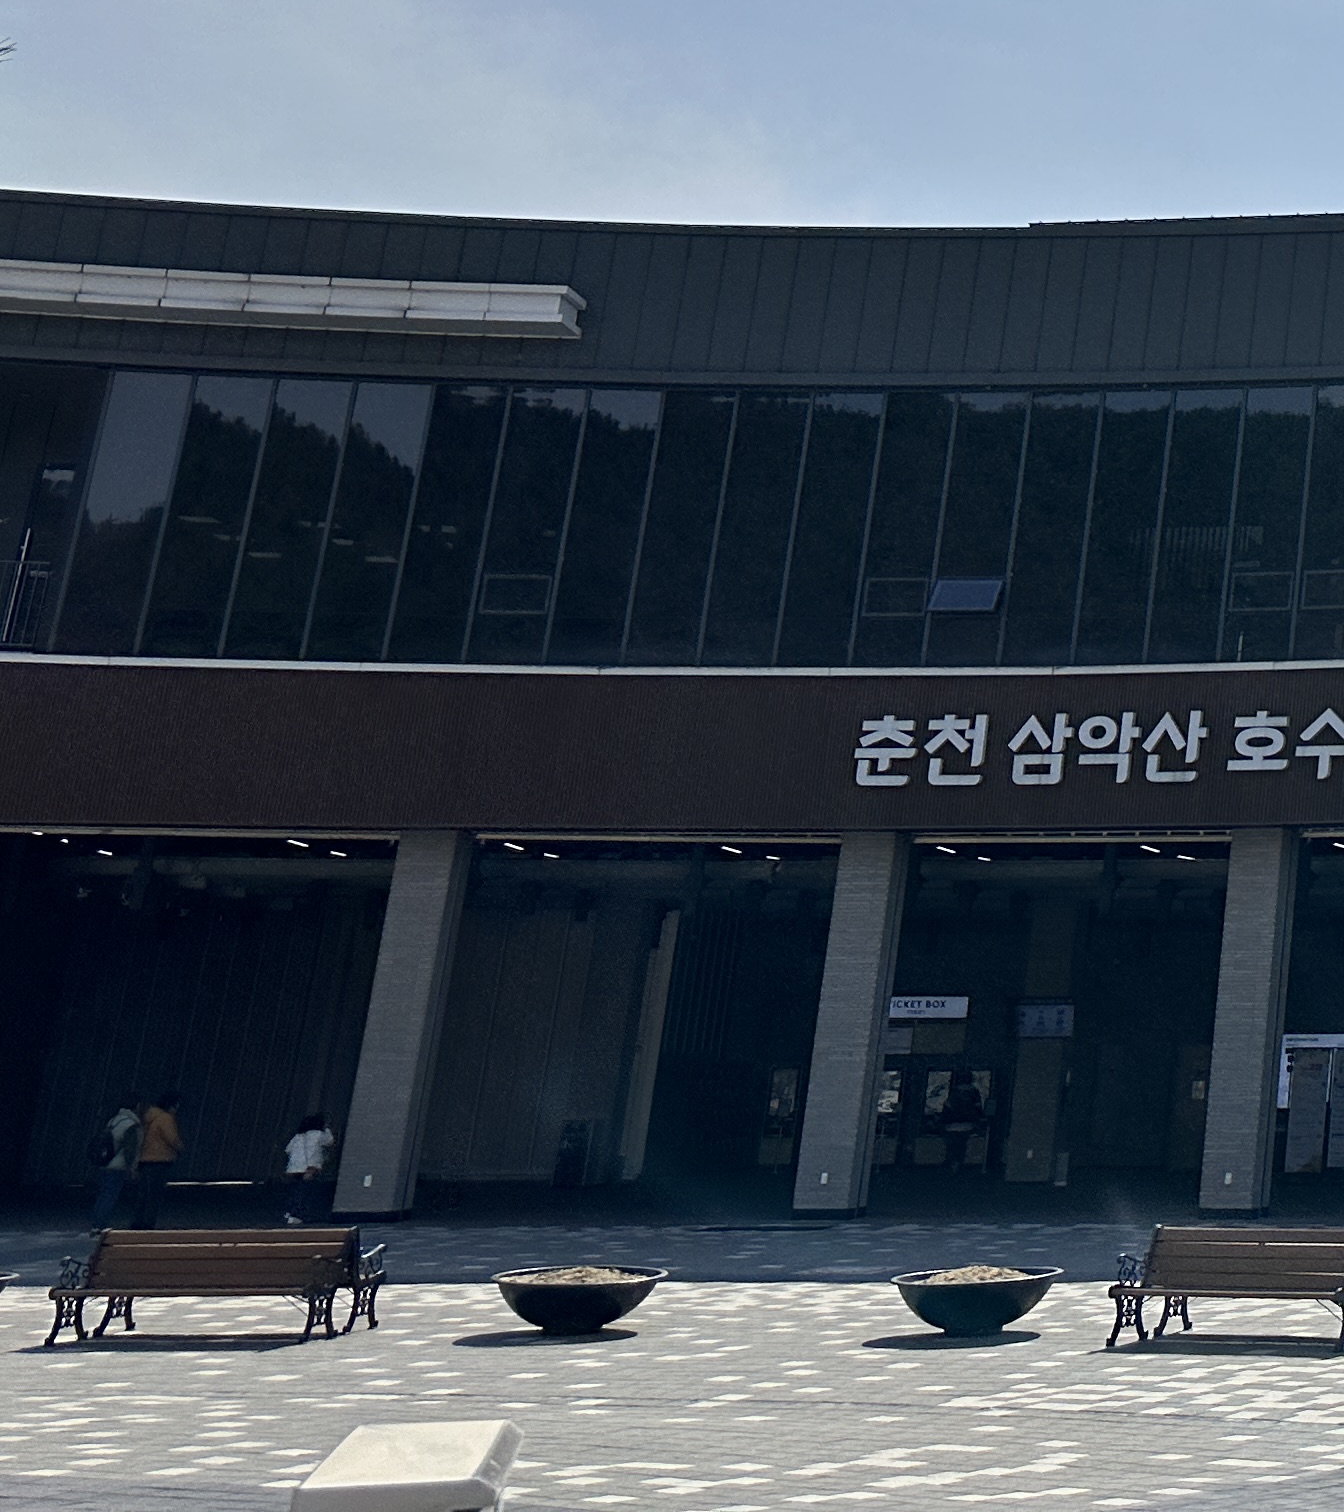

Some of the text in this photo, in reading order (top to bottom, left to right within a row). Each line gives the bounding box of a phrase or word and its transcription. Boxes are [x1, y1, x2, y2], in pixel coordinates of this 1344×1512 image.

[853, 713, 990, 787] 춘천
[1007, 709, 1209, 786] 삼악산
[925, 999, 946, 1009] BOX
